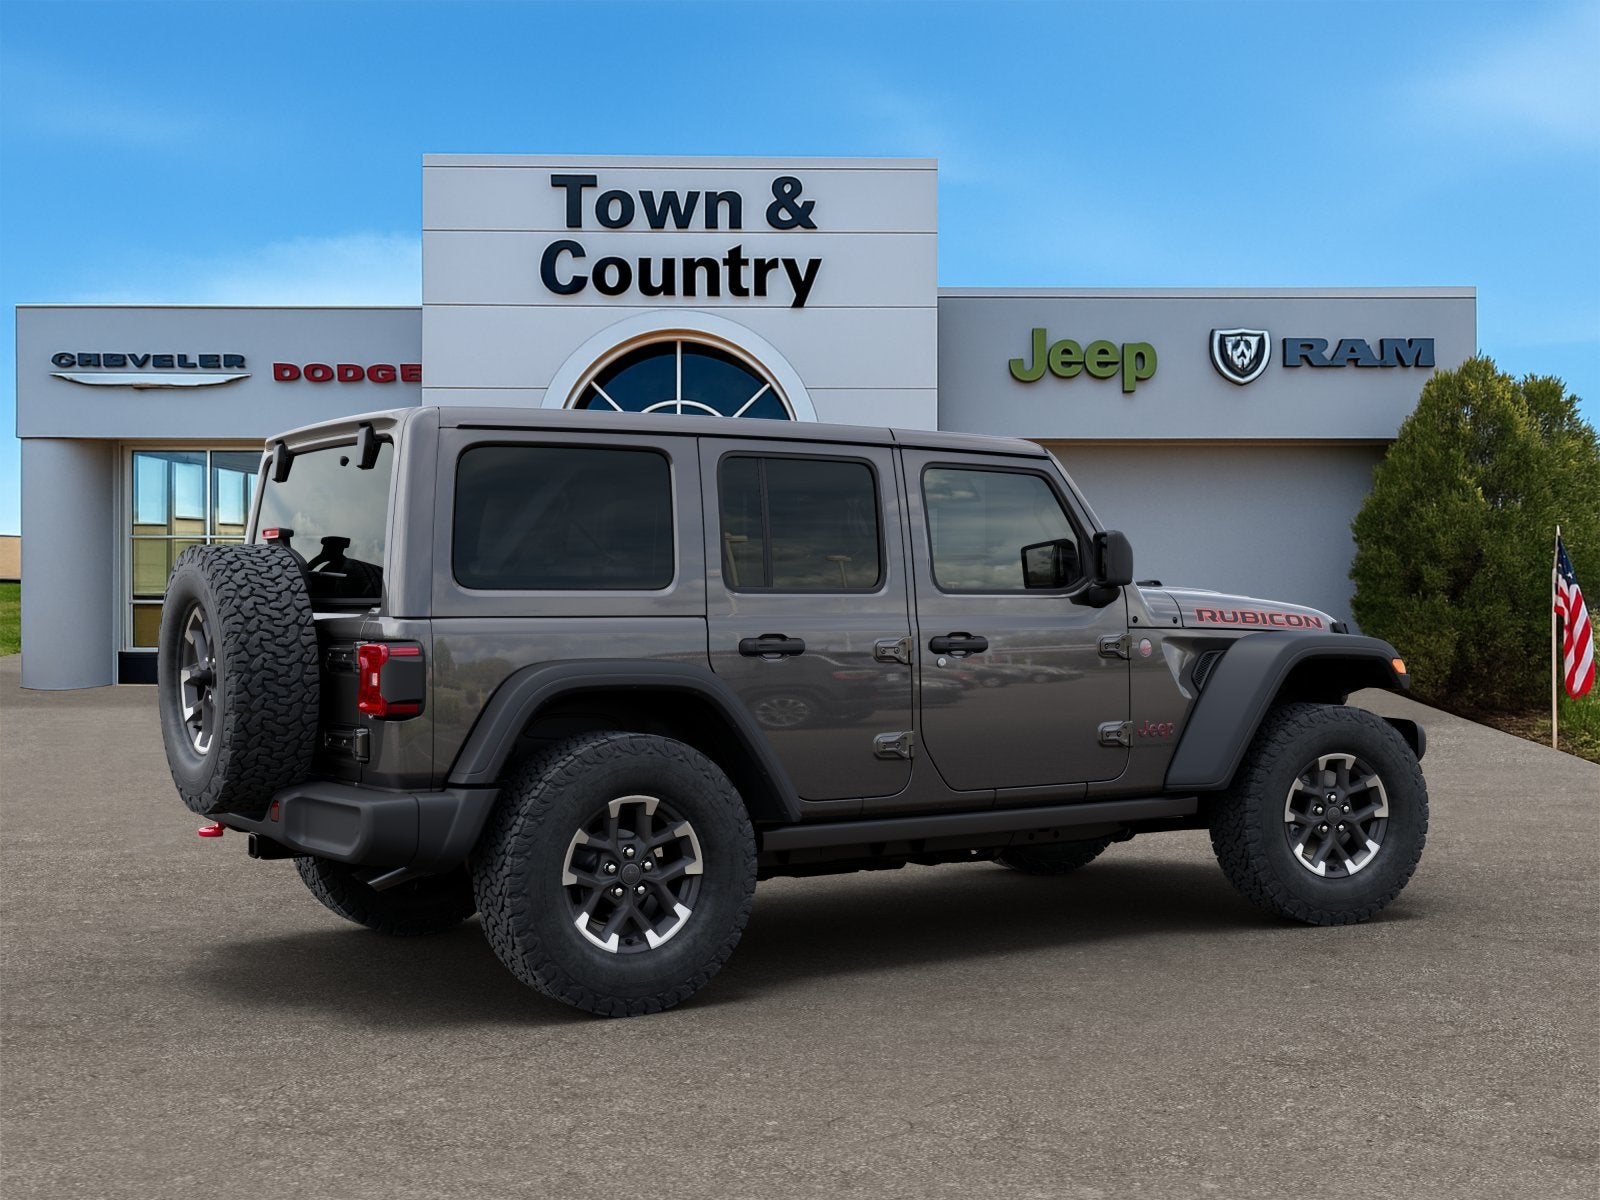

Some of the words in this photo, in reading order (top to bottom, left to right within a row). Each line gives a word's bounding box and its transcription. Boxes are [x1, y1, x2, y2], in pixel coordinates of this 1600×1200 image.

[551, 174, 742, 229] Town
[766, 176, 818, 229] &
[540, 239, 822, 308] Country
[1009, 328, 1158, 392] Jeep
[1283, 337, 1436, 368] RAM
[273, 362, 422, 384] DODGE
[1194, 608, 1323, 630] RUBICON
[1138, 720, 1175, 739] Jeep
